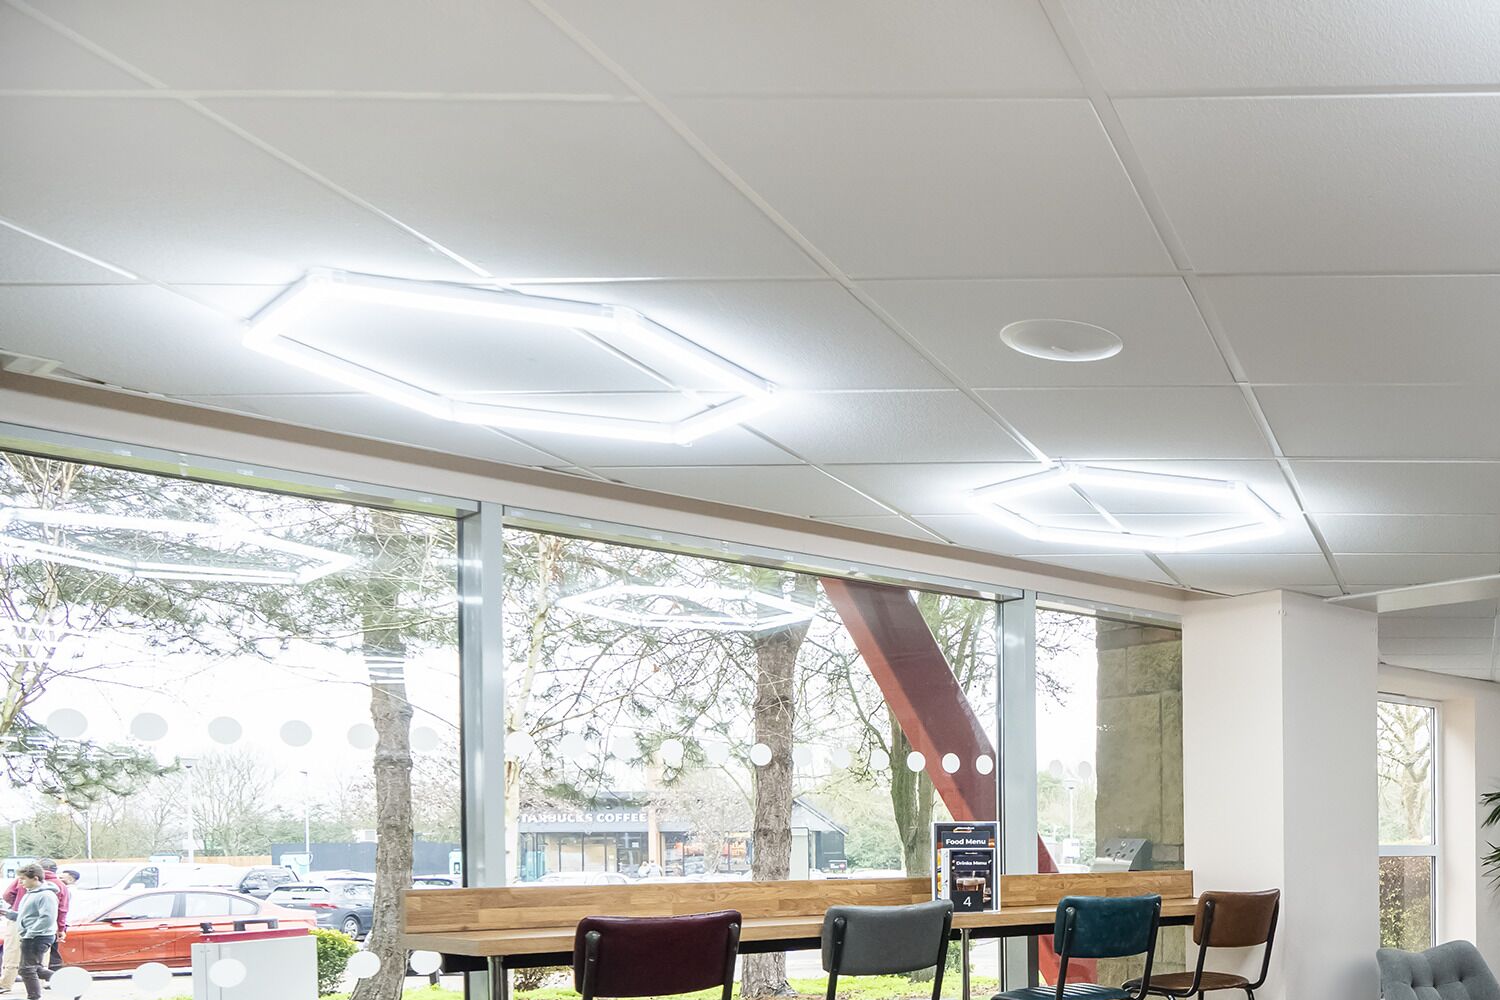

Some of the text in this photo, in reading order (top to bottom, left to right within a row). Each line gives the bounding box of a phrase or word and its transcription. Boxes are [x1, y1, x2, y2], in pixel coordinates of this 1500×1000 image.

[517, 812, 648, 823] TARBUCKS COFFEE
[963, 896, 972, 907] 4
